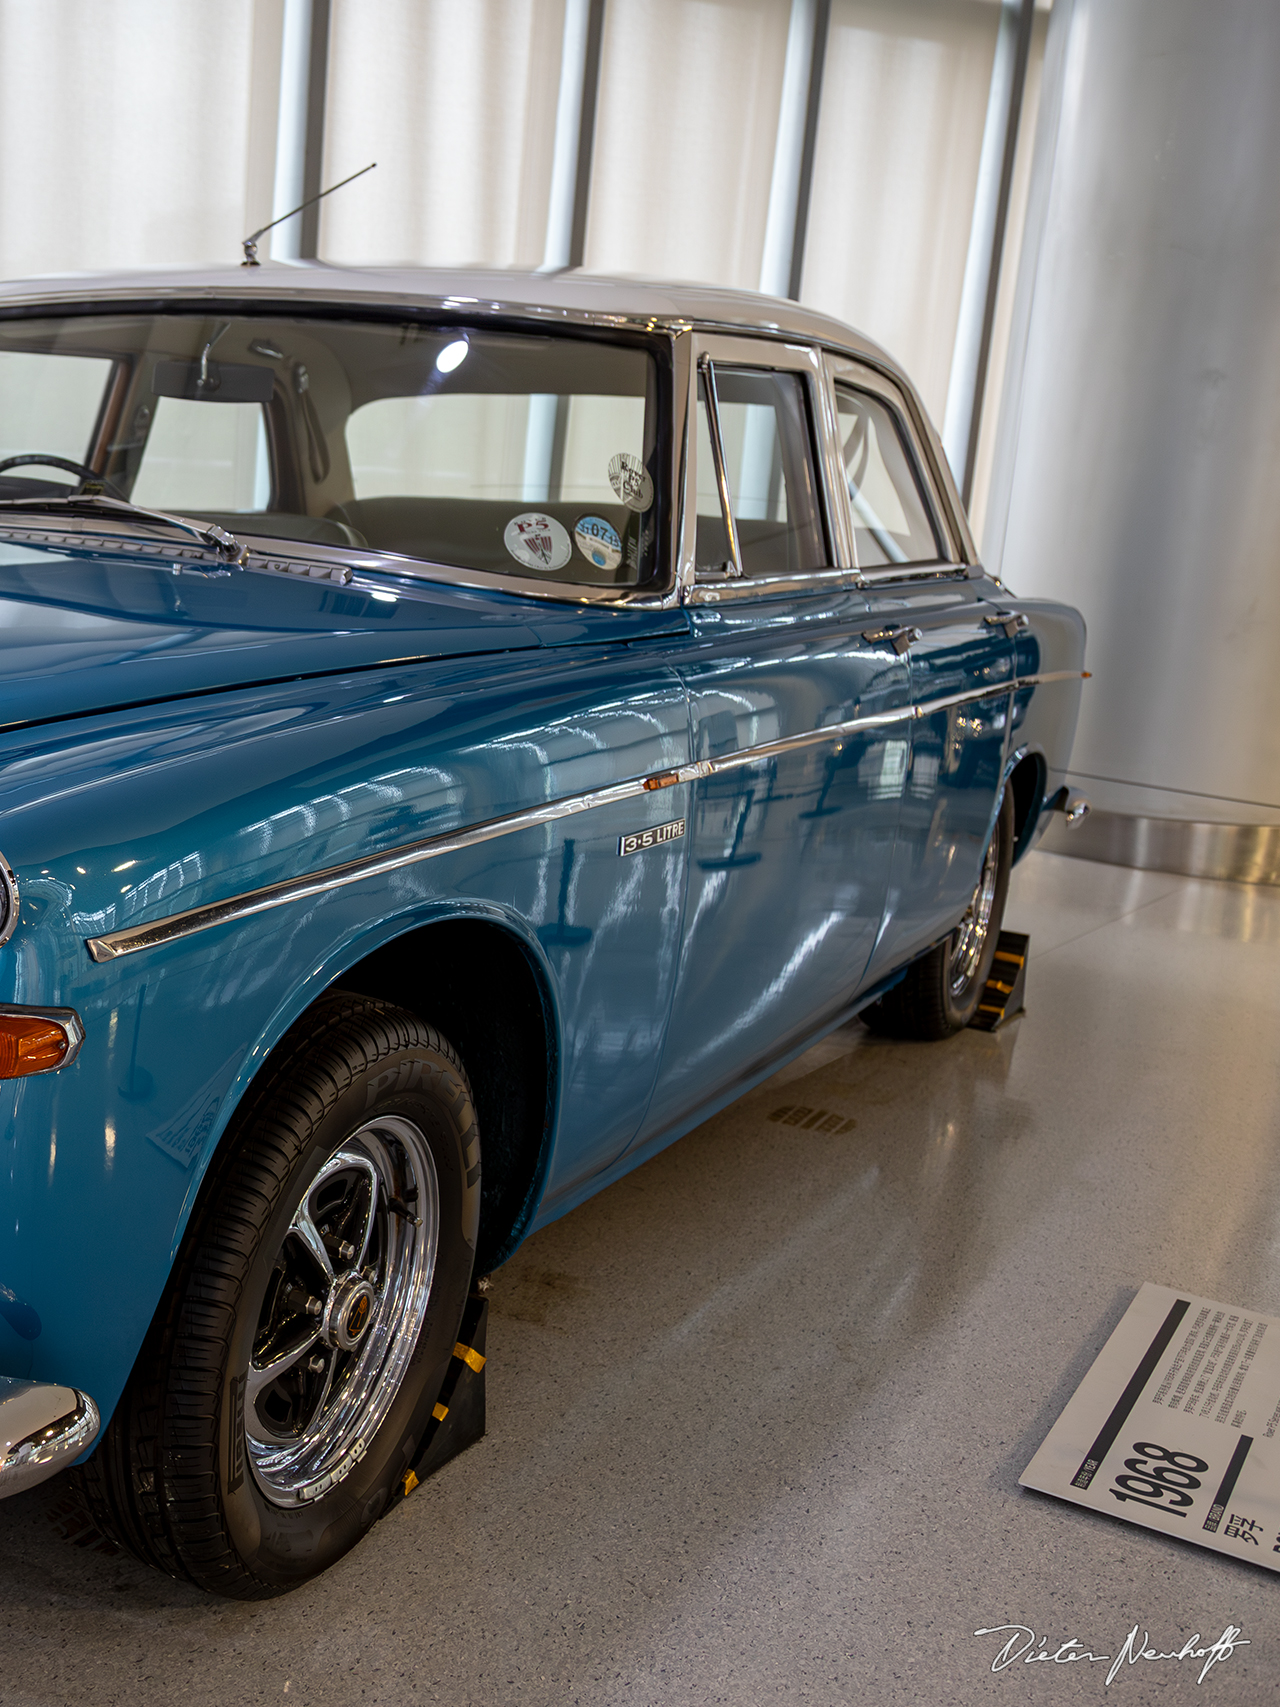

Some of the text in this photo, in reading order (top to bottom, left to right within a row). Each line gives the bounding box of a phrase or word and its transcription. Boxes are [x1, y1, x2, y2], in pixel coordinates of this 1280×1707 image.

[517, 520, 550, 533] P5
[591, 523, 608, 540] 07
[656, 821, 685, 842] LITRE
[364, 1058, 483, 1189] PIRELLI
[1108, 1441, 1209, 1518] 1968
[1223, 1513, 1264, 1546] 罗孚
